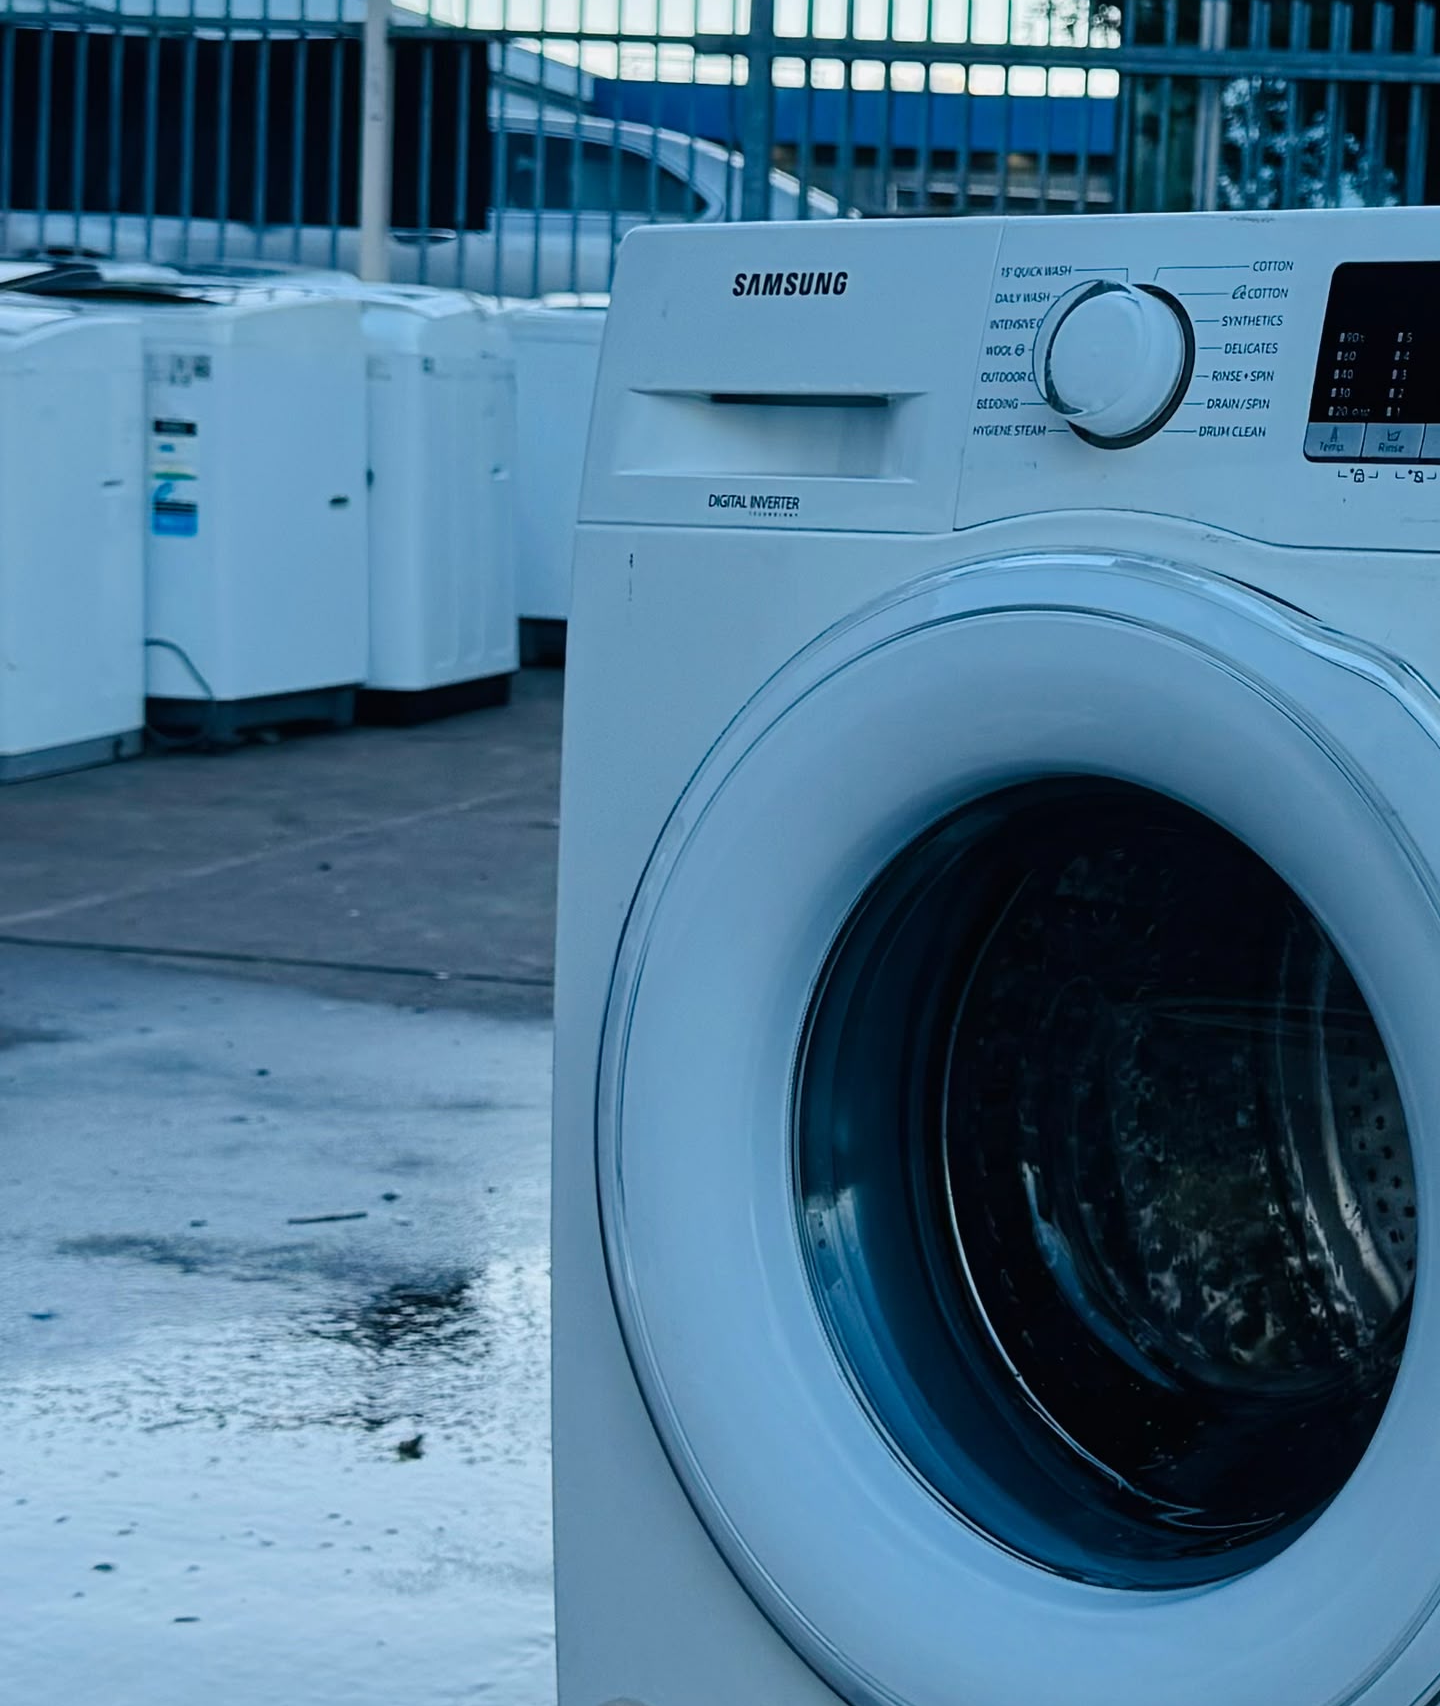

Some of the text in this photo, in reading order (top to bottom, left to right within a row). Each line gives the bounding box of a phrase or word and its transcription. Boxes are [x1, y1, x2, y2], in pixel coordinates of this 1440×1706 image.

[1014, 266, 1043, 278] QUICK
[1044, 265, 1072, 277] WASH
[1252, 260, 1294, 272] COTTON
[731, 271, 849, 297] SAMSUNG
[994, 291, 1050, 304] DAILY WASH
[989, 318, 1036, 330] INTENSIVE
[1221, 315, 1284, 327] SYNTHETICS
[985, 345, 1012, 356] WOOL
[1224, 342, 1279, 354] DELICATES
[980, 371, 1026, 383] OUTDOOR
[1211, 370, 1243, 382] RINSE
[1250, 370, 1275, 382] SPIN
[976, 398, 1019, 410] BEDDING
[972, 425, 1047, 437] HYGIENE STEAM
[1198, 425, 1267, 437] DRUM CLEAN
[1378, 442, 1404, 453] Rinse
[708, 493, 800, 510] DIGITAL INVERTER
